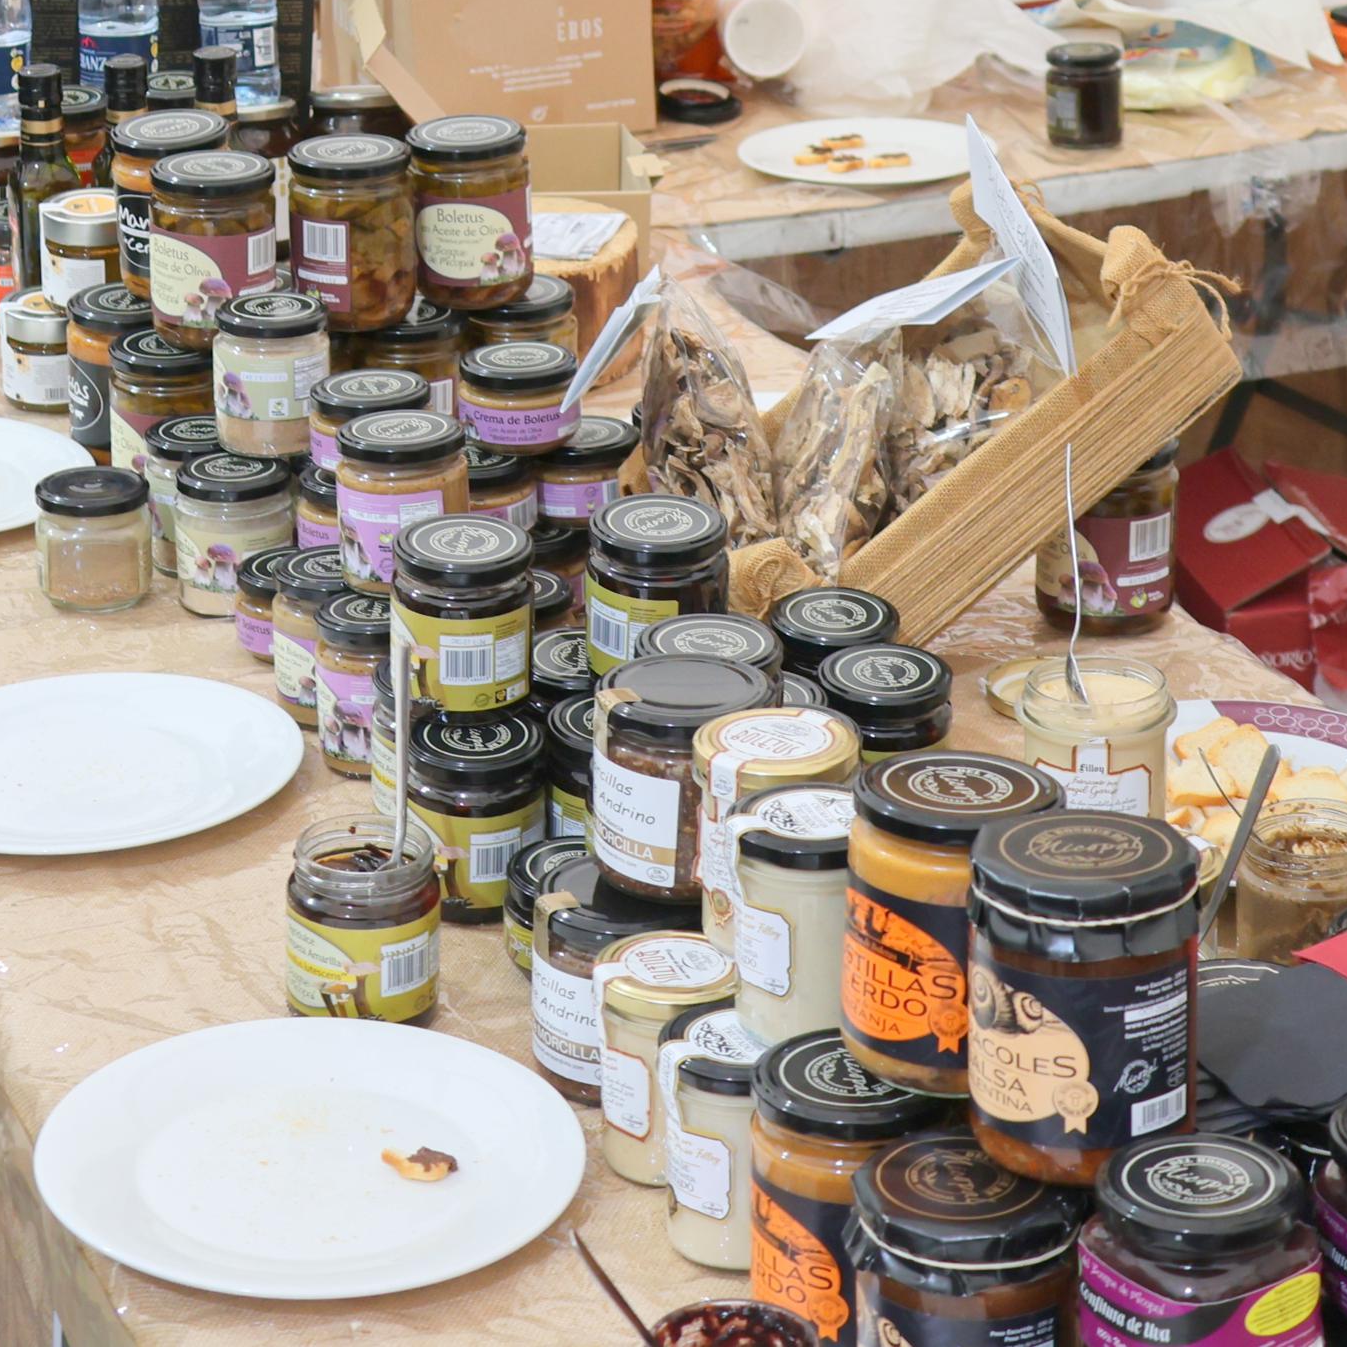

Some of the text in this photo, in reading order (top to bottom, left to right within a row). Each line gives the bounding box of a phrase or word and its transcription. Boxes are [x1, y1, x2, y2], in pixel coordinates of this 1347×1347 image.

[437, 208, 485, 223] Boletus
[432, 225, 458, 236] Aceite
[464, 226, 476, 237] de
[479, 225, 505, 236] Oliva
[473, 411, 560, 425] Crema de Boletus
[598, 790, 656, 825] Andrino
[1025, 836, 1142, 856] Micopal
[1080, 1282, 1171, 1343] Confitura de Uva
[1129, 1290, 1165, 1315] Micopal
